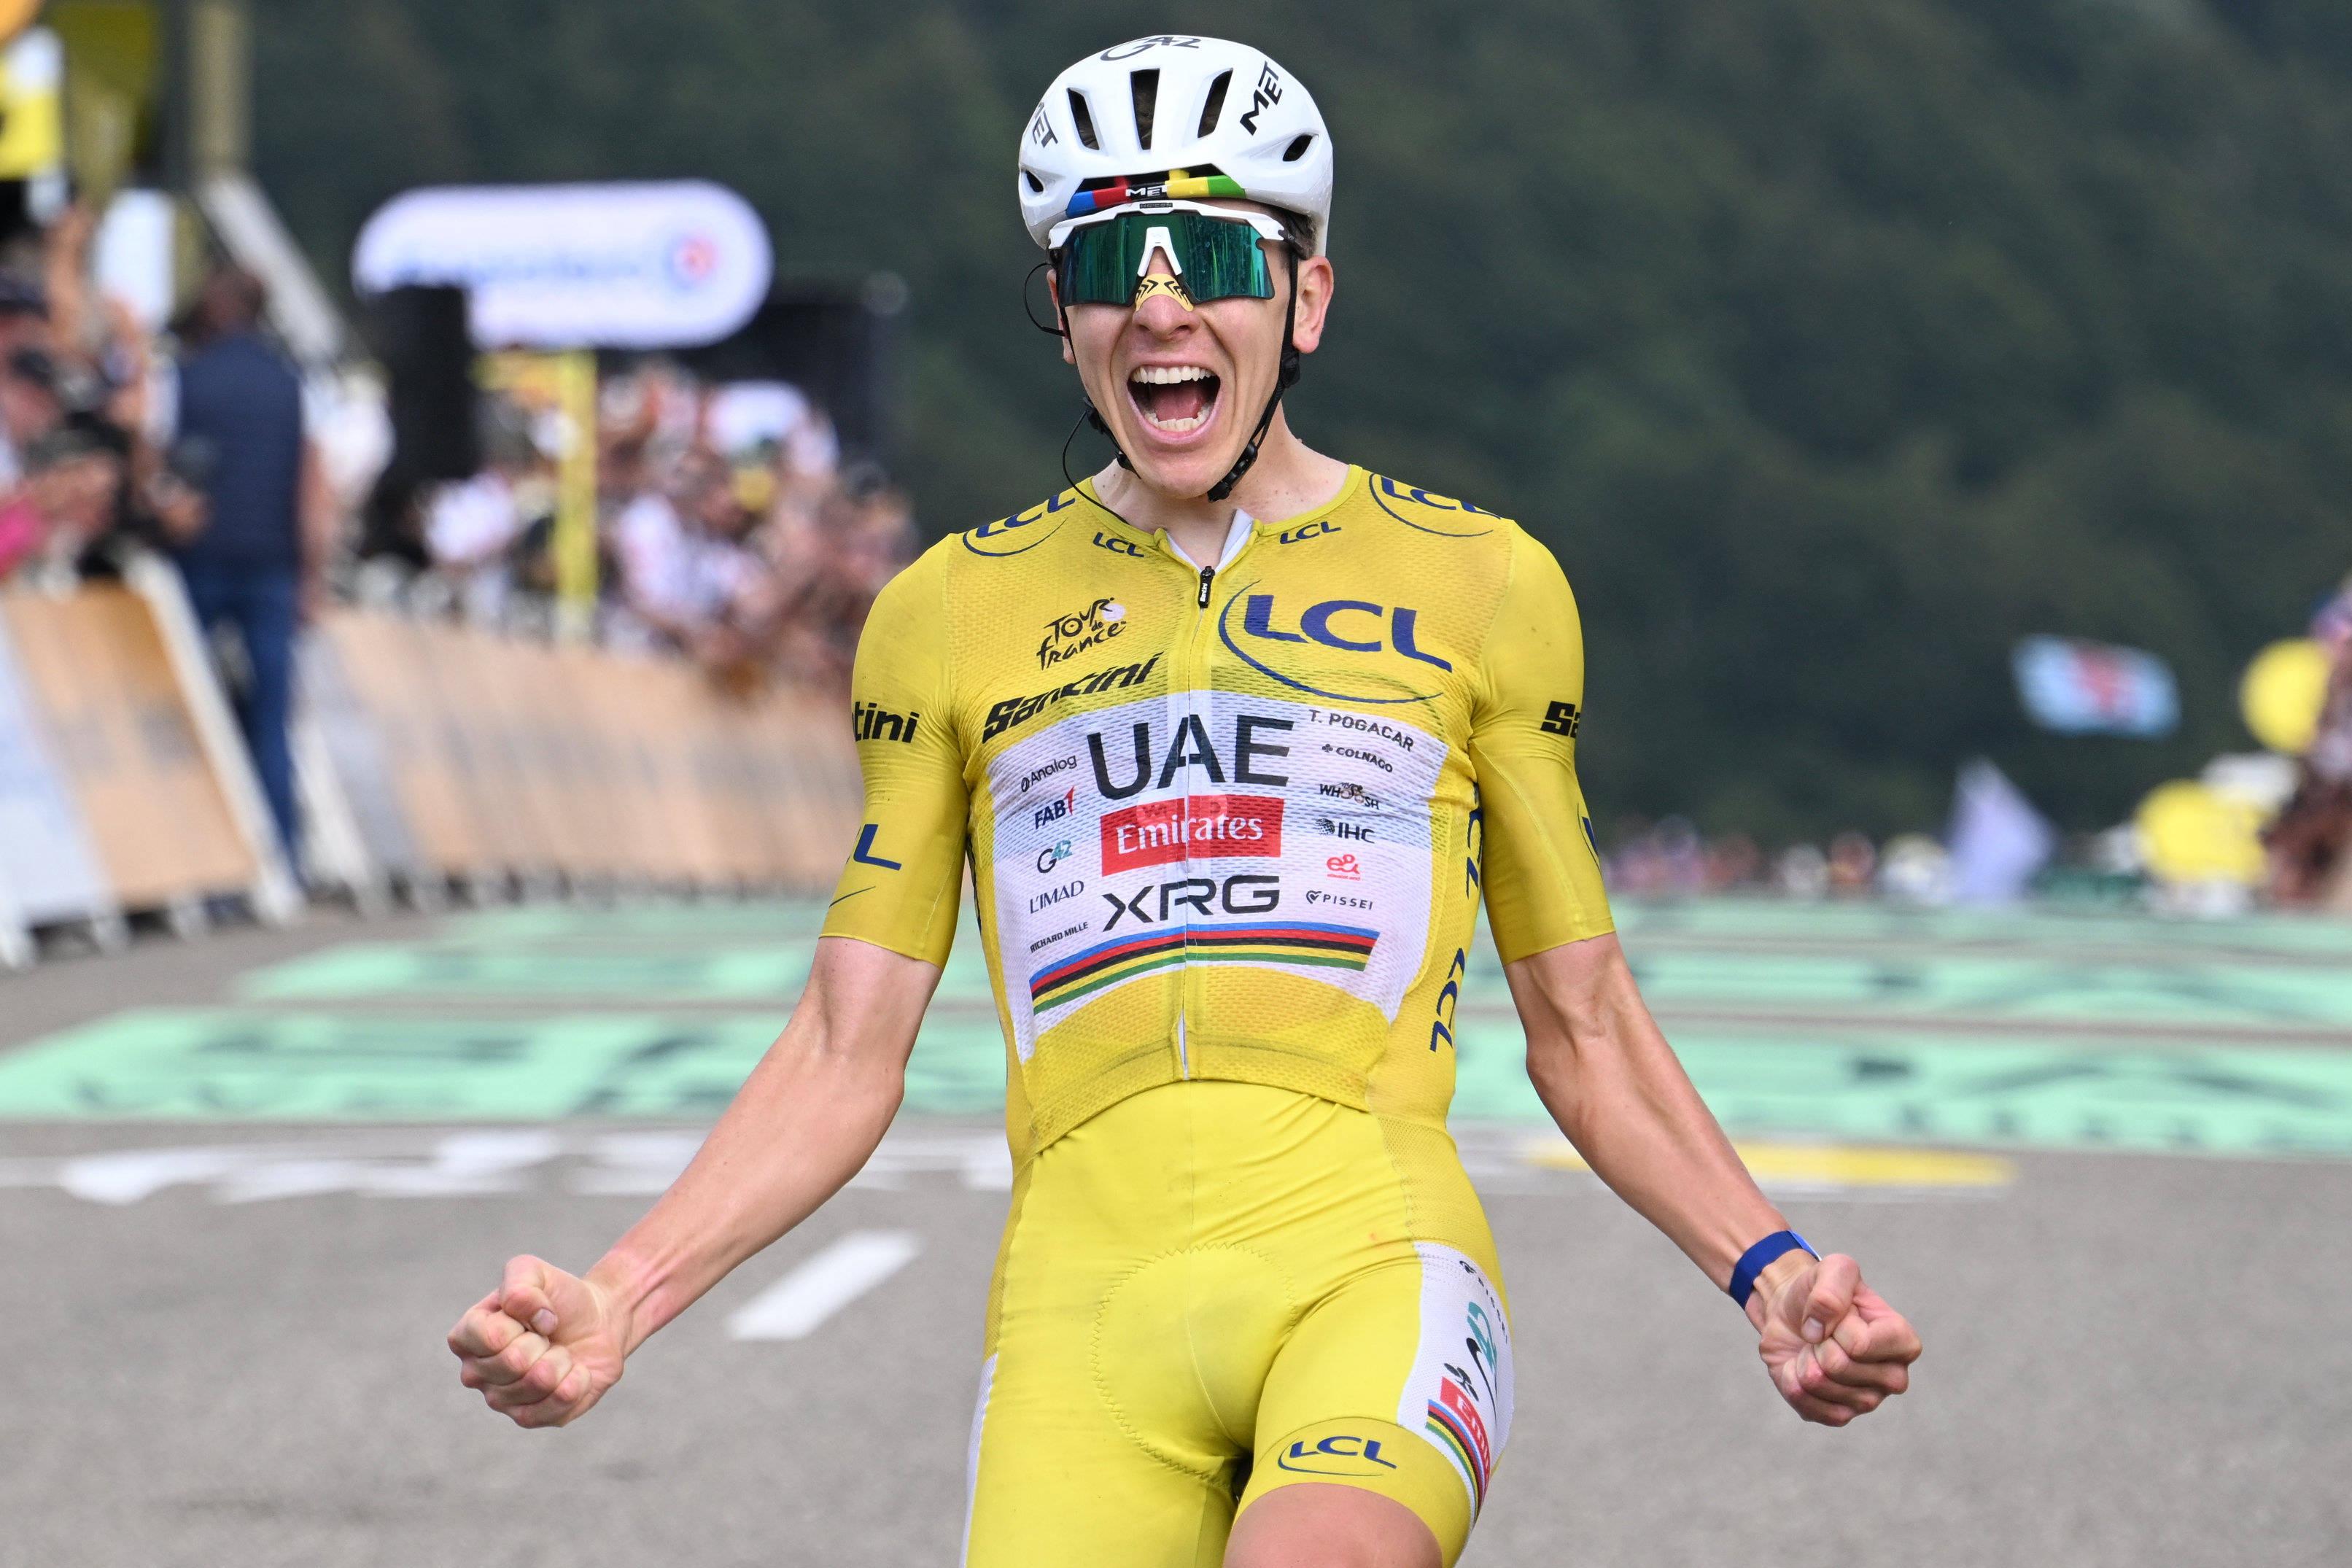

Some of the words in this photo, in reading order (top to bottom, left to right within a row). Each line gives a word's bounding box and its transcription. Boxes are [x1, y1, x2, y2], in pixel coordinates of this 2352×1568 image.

[1239, 61, 1284, 136] MET
[1092, 532, 1144, 558] LCL
[1280, 521, 1341, 545] LCL
[1243, 595, 1452, 673] LCL
[982, 651, 1164, 744] Santini
[852, 701, 920, 743] tini
[1309, 709, 1321, 723] T.
[1329, 713, 1415, 752] POGACAR
[1031, 755, 1077, 785] Analog
[1087, 714, 1295, 800] UAE
[1335, 746, 1393, 772] COLNAGO
[1115, 814, 1263, 855] Emirates
[1338, 822, 1375, 844] IHC
[1037, 840, 1072, 874] G42
[1102, 875, 1281, 932] XRG
[1323, 893, 1373, 910] PISSEI
[1030, 932, 1063, 953] RICHARD
[1064, 921, 1089, 937] MILLE
[1289, 1436, 1397, 1470] LCL
